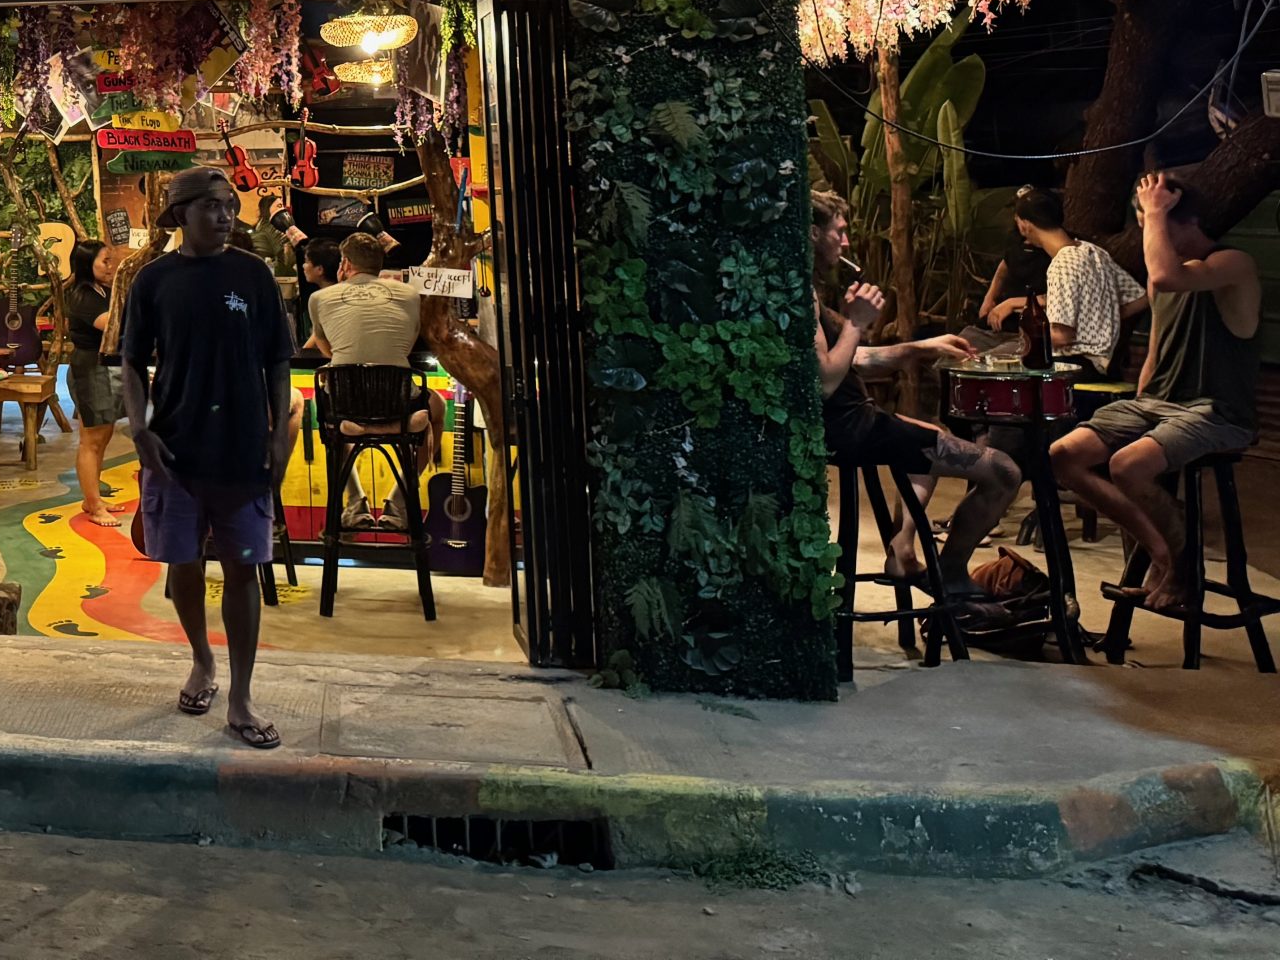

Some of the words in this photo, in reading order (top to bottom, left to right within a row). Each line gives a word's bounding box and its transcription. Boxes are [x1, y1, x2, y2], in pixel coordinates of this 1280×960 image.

[103, 76, 134, 88] GUNS
[140, 115, 161, 129] FLOYD
[106, 131, 141, 146] BLACK
[142, 133, 191, 149] SABBATH
[348, 161, 371, 170] THING
[373, 162, 380, 171] IS
[347, 169, 372, 177] GONNA
[345, 177, 390, 189] ARRIGHT
[410, 267, 423, 278] We
[448, 271, 471, 285] accept
